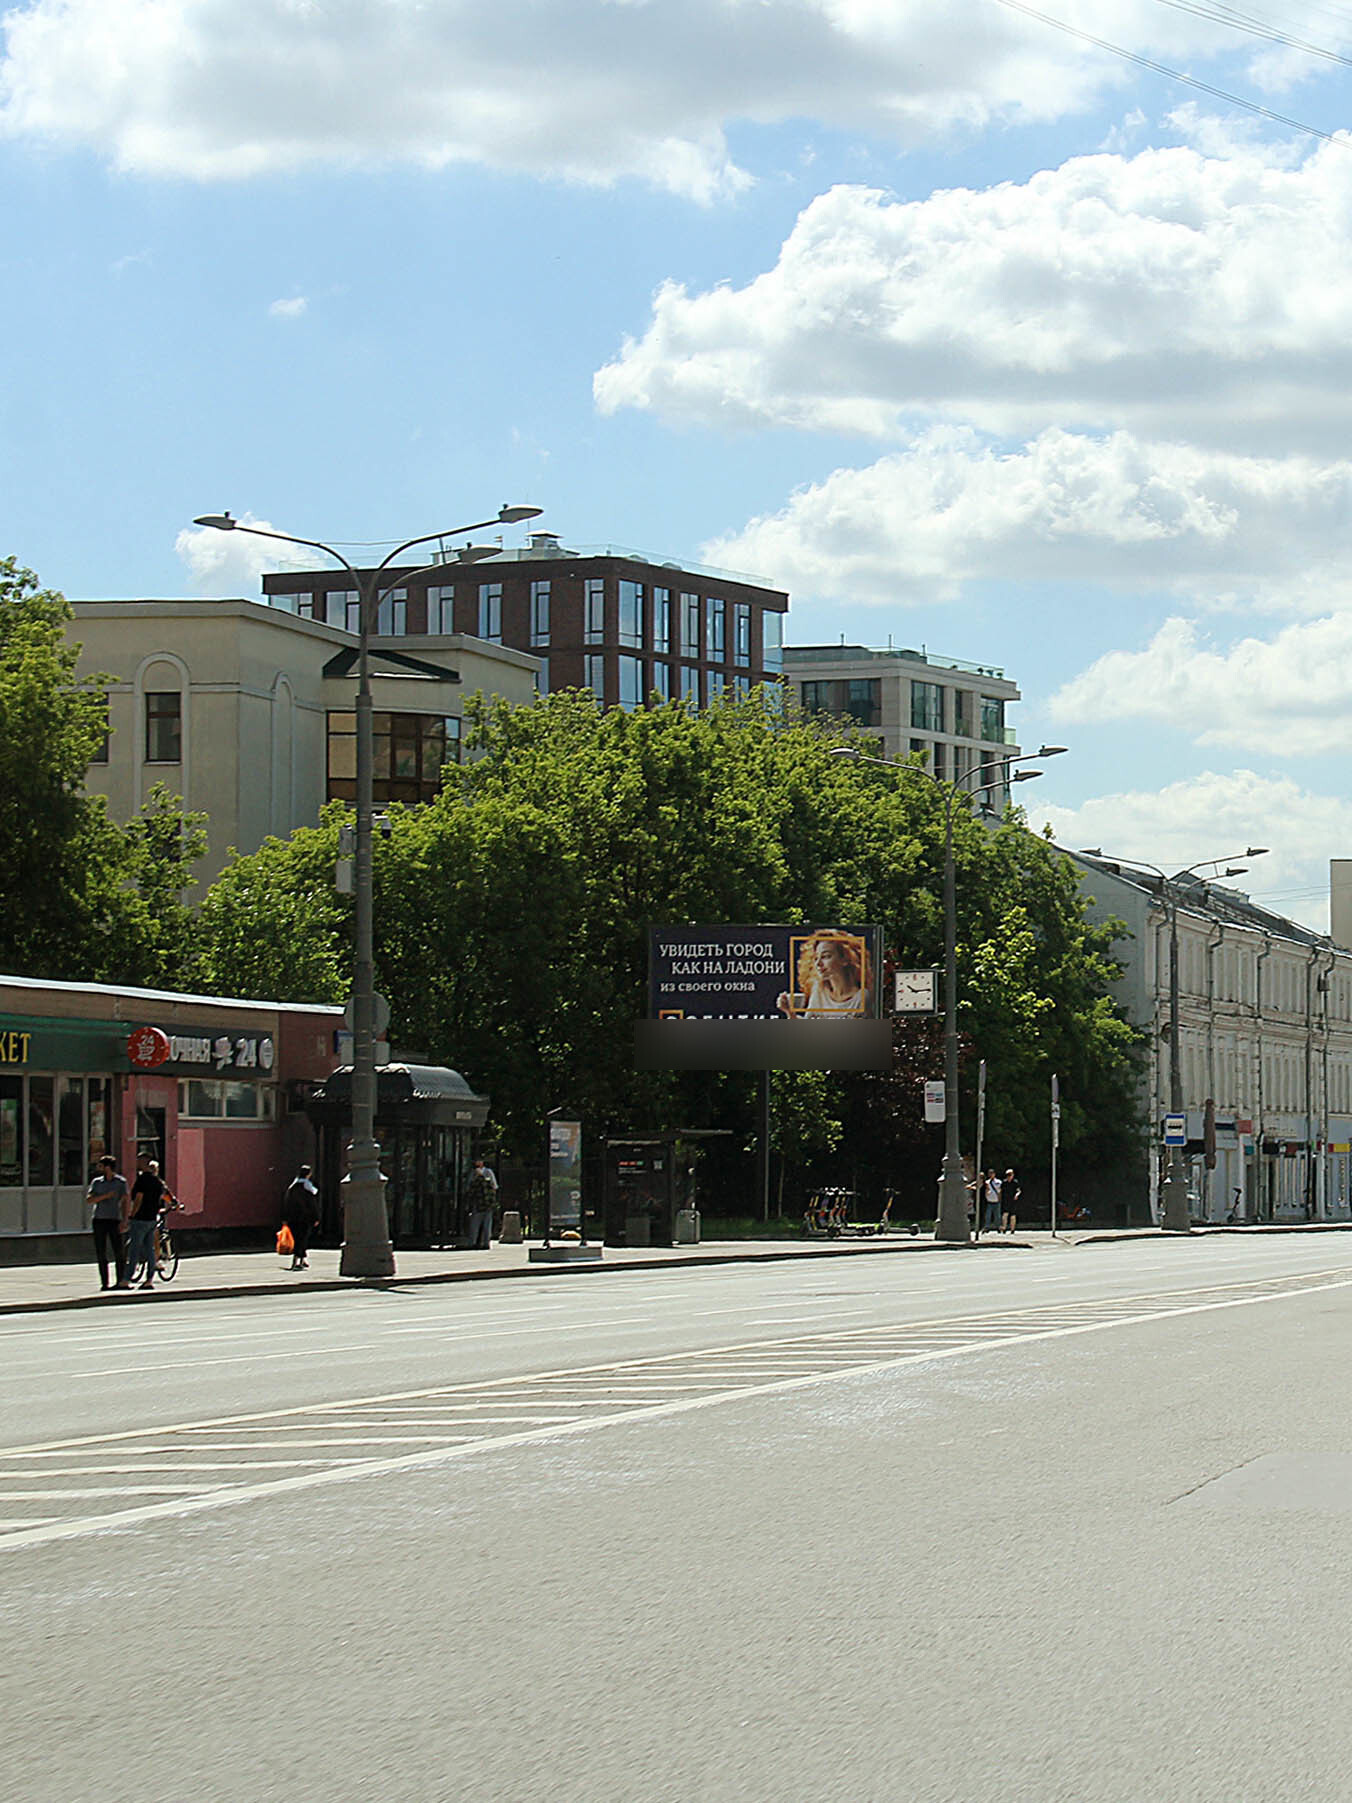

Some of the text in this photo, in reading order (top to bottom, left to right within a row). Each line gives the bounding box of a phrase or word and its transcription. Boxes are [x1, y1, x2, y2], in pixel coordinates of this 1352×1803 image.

[659, 943, 774, 958] УВИДЕТЬ ГОРОД
[671, 961, 785, 975] КАК НА ЛАДОНИ
[659, 981, 756, 993] из своего окна
[235, 1037, 257, 1068] 24
